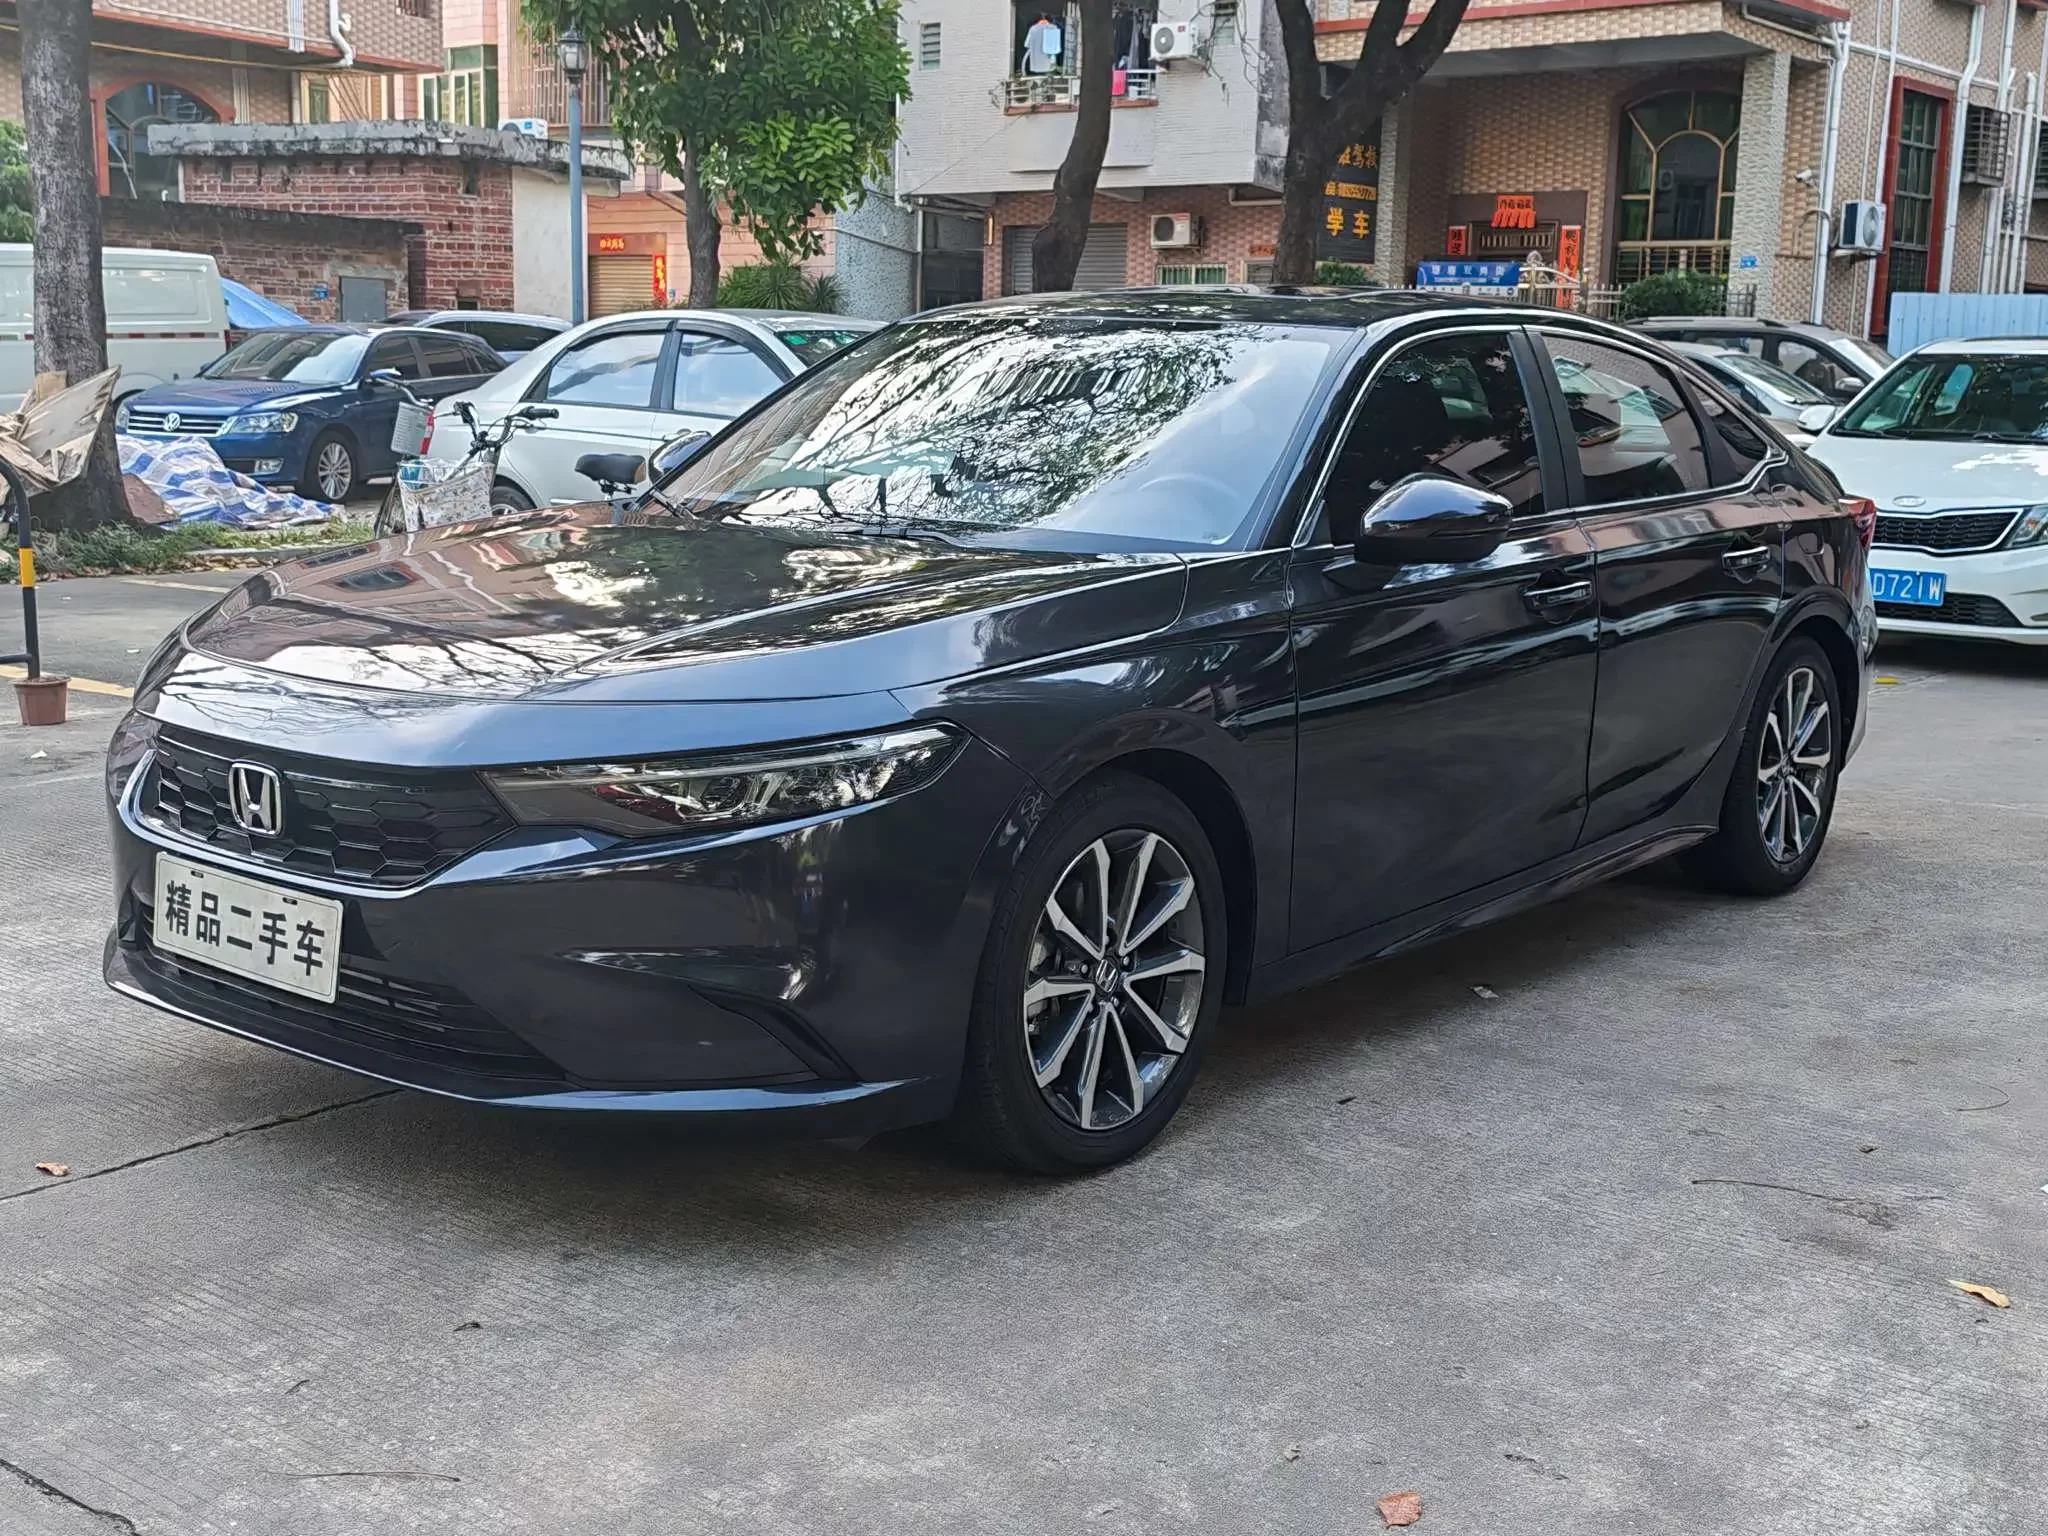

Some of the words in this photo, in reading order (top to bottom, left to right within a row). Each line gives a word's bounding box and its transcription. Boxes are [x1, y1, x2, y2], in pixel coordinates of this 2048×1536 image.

[1325, 207, 1371, 239] 学车
[1873, 573, 1942, 600] D721W
[165, 880, 326, 977] 精品二手车
